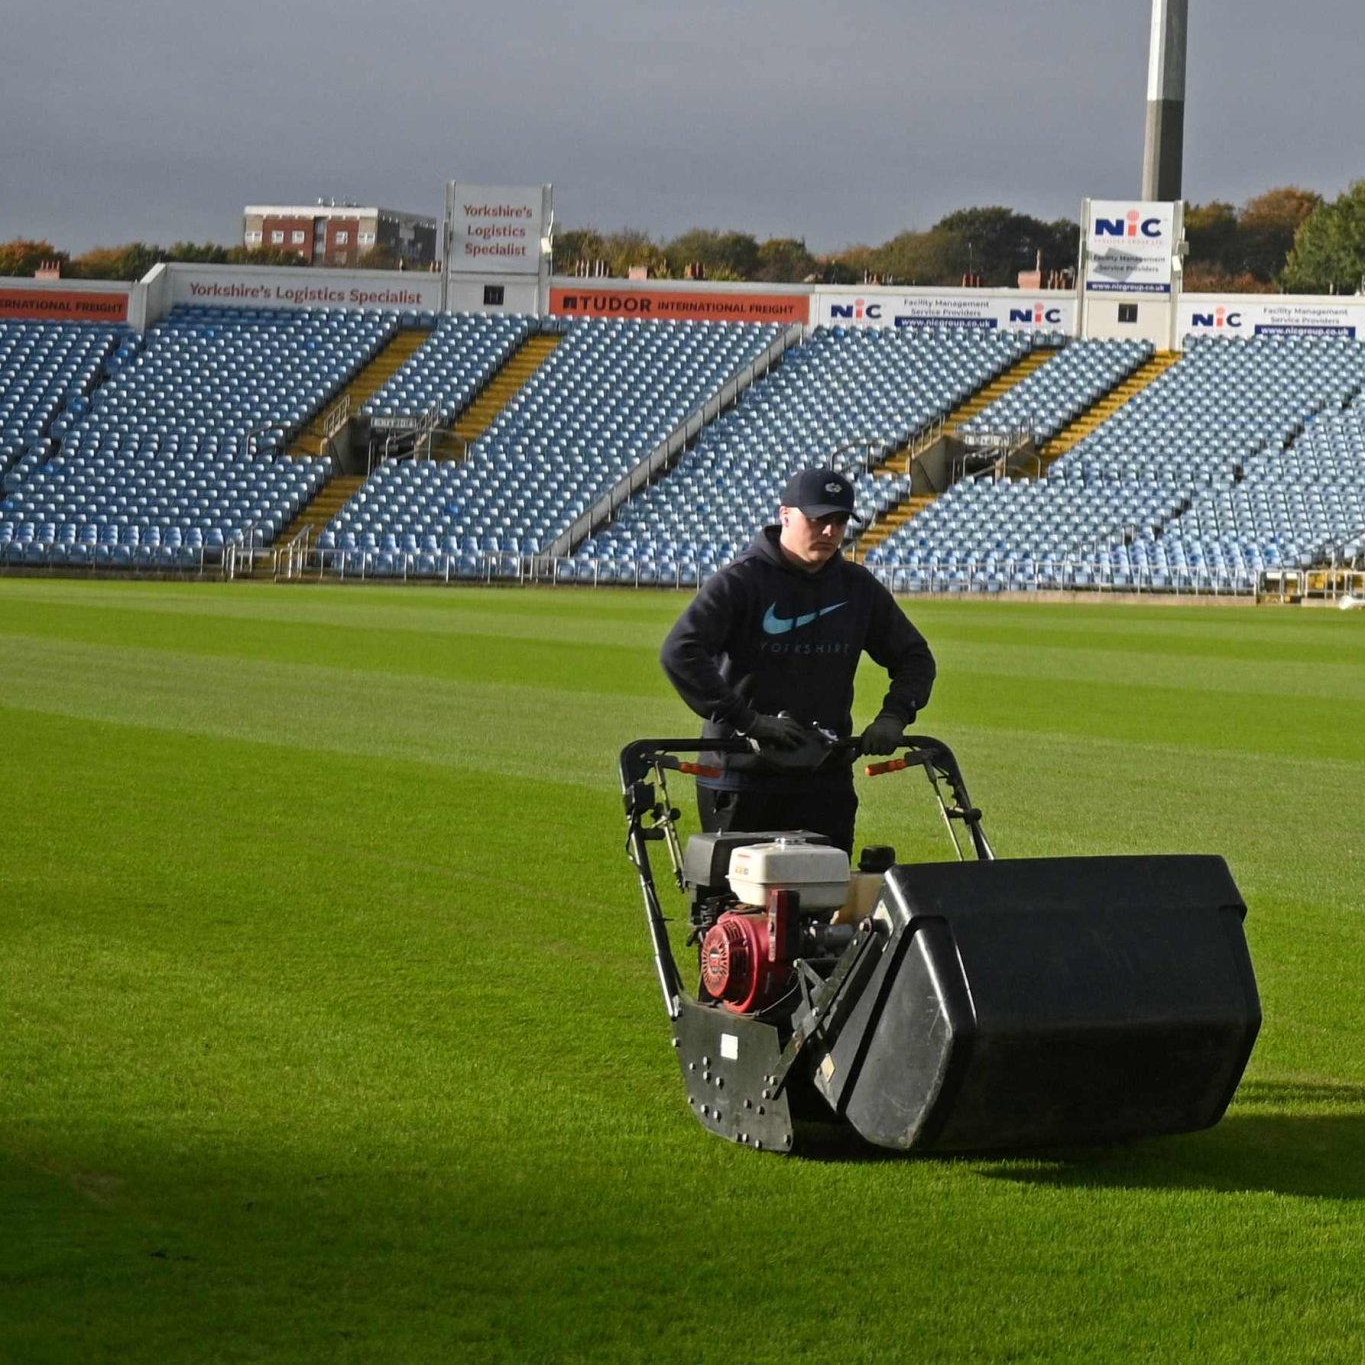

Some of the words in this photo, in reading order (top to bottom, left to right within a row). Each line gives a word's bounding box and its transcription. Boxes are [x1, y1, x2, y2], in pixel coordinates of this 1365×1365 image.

[464, 204, 533, 218] Yorkshire's
[467, 224, 526, 239] Logistics
[465, 243, 526, 257] Specialist
[1094, 255, 1117, 263] Facility
[1120, 256, 1165, 264] Management
[1092, 283, 1164, 292] www.nicgroup.co.uk
[190, 283, 271, 298] Yorkshire's
[276, 286, 345, 303] Logistics
[350, 289, 422, 305] Specialist
[75, 301, 123, 313] FREIGHT
[580, 296, 651, 312] TUDOR
[657, 301, 746, 313] INTERNATIONAL
[750, 304, 794, 315] FREIGHT
[904, 299, 933, 309] Facility
[935, 300, 989, 310] Management
[911, 308, 940, 316] Service
[942, 309, 981, 317] Providers
[1264, 307, 1292, 316] Facility
[1294, 308, 1348, 317] Management
[901, 319, 990, 329] www.nicgroup.co.uk
[1271, 316, 1299, 324] Service
[1302, 317, 1339, 325] Providers
